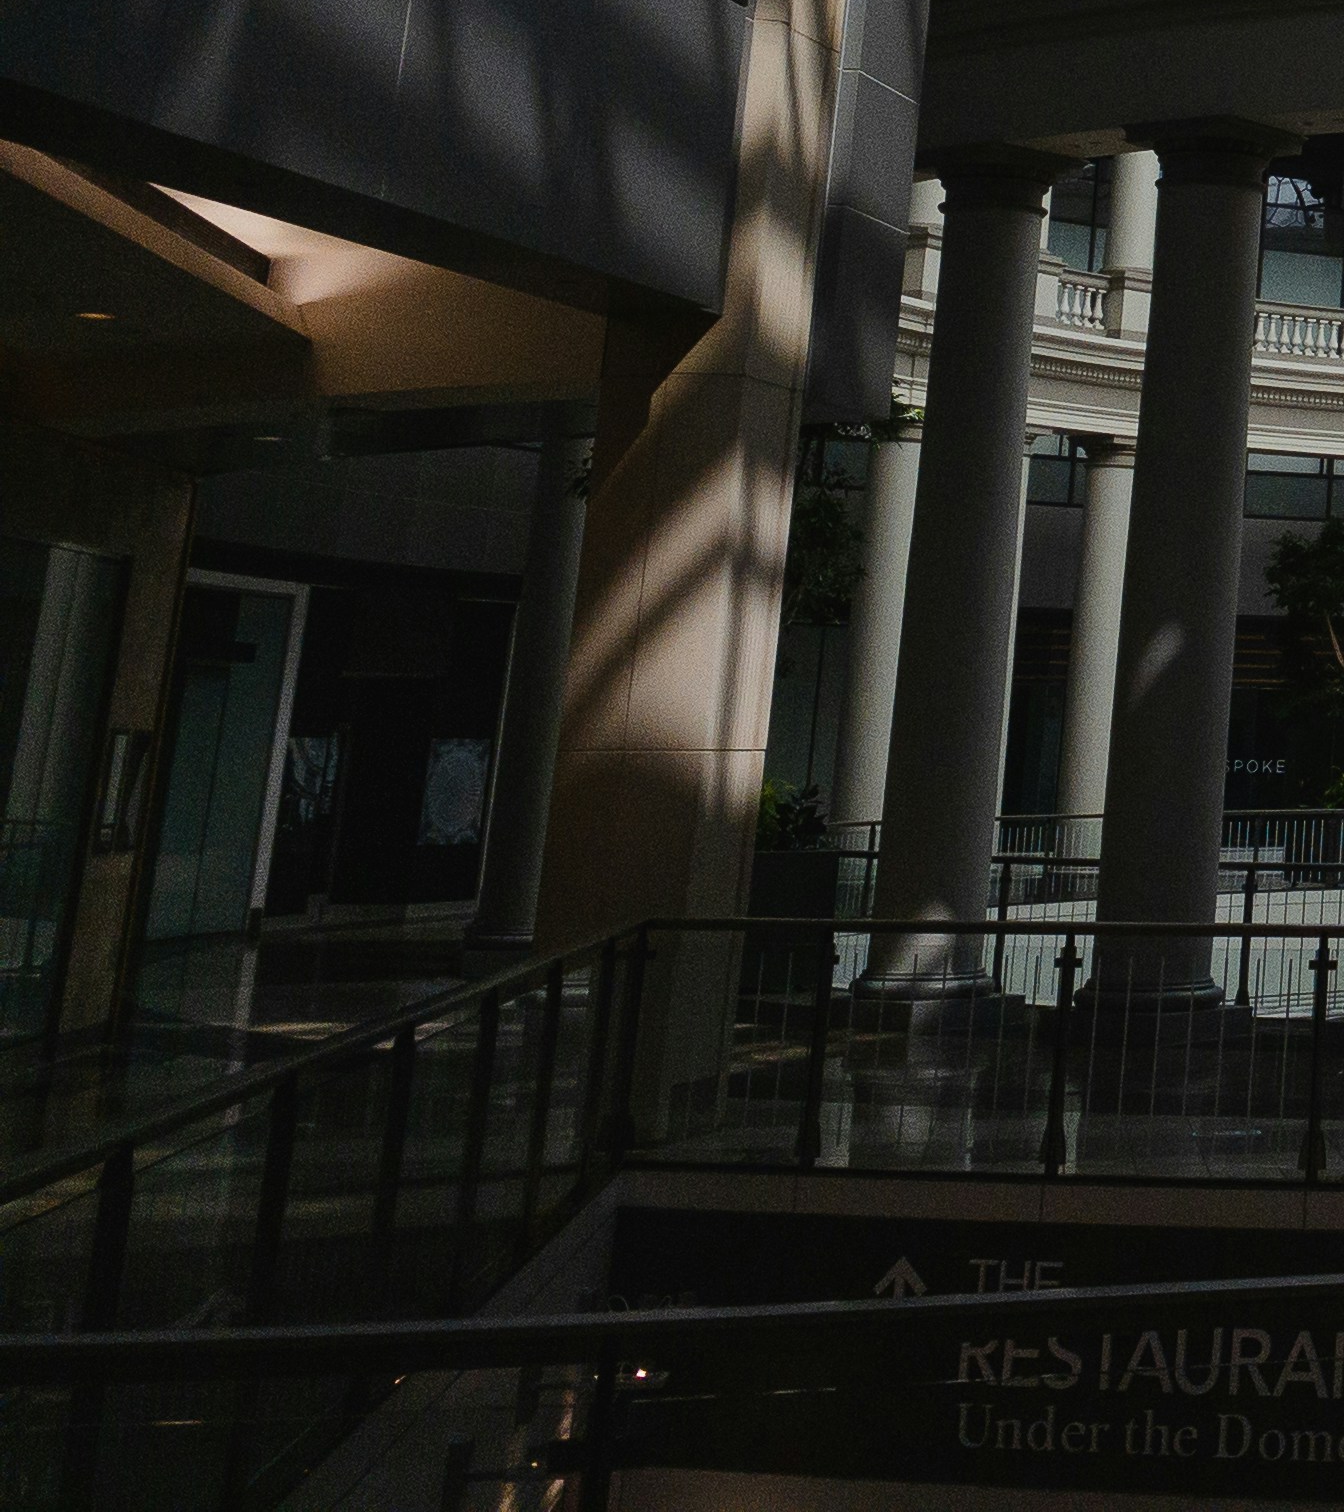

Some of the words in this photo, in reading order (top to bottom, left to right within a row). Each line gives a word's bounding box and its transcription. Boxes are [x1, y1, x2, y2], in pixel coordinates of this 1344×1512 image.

[968, 1258, 1064, 1291] THE
[958, 1402, 1110, 1453] Under
[1124, 1409, 1199, 1458] the
